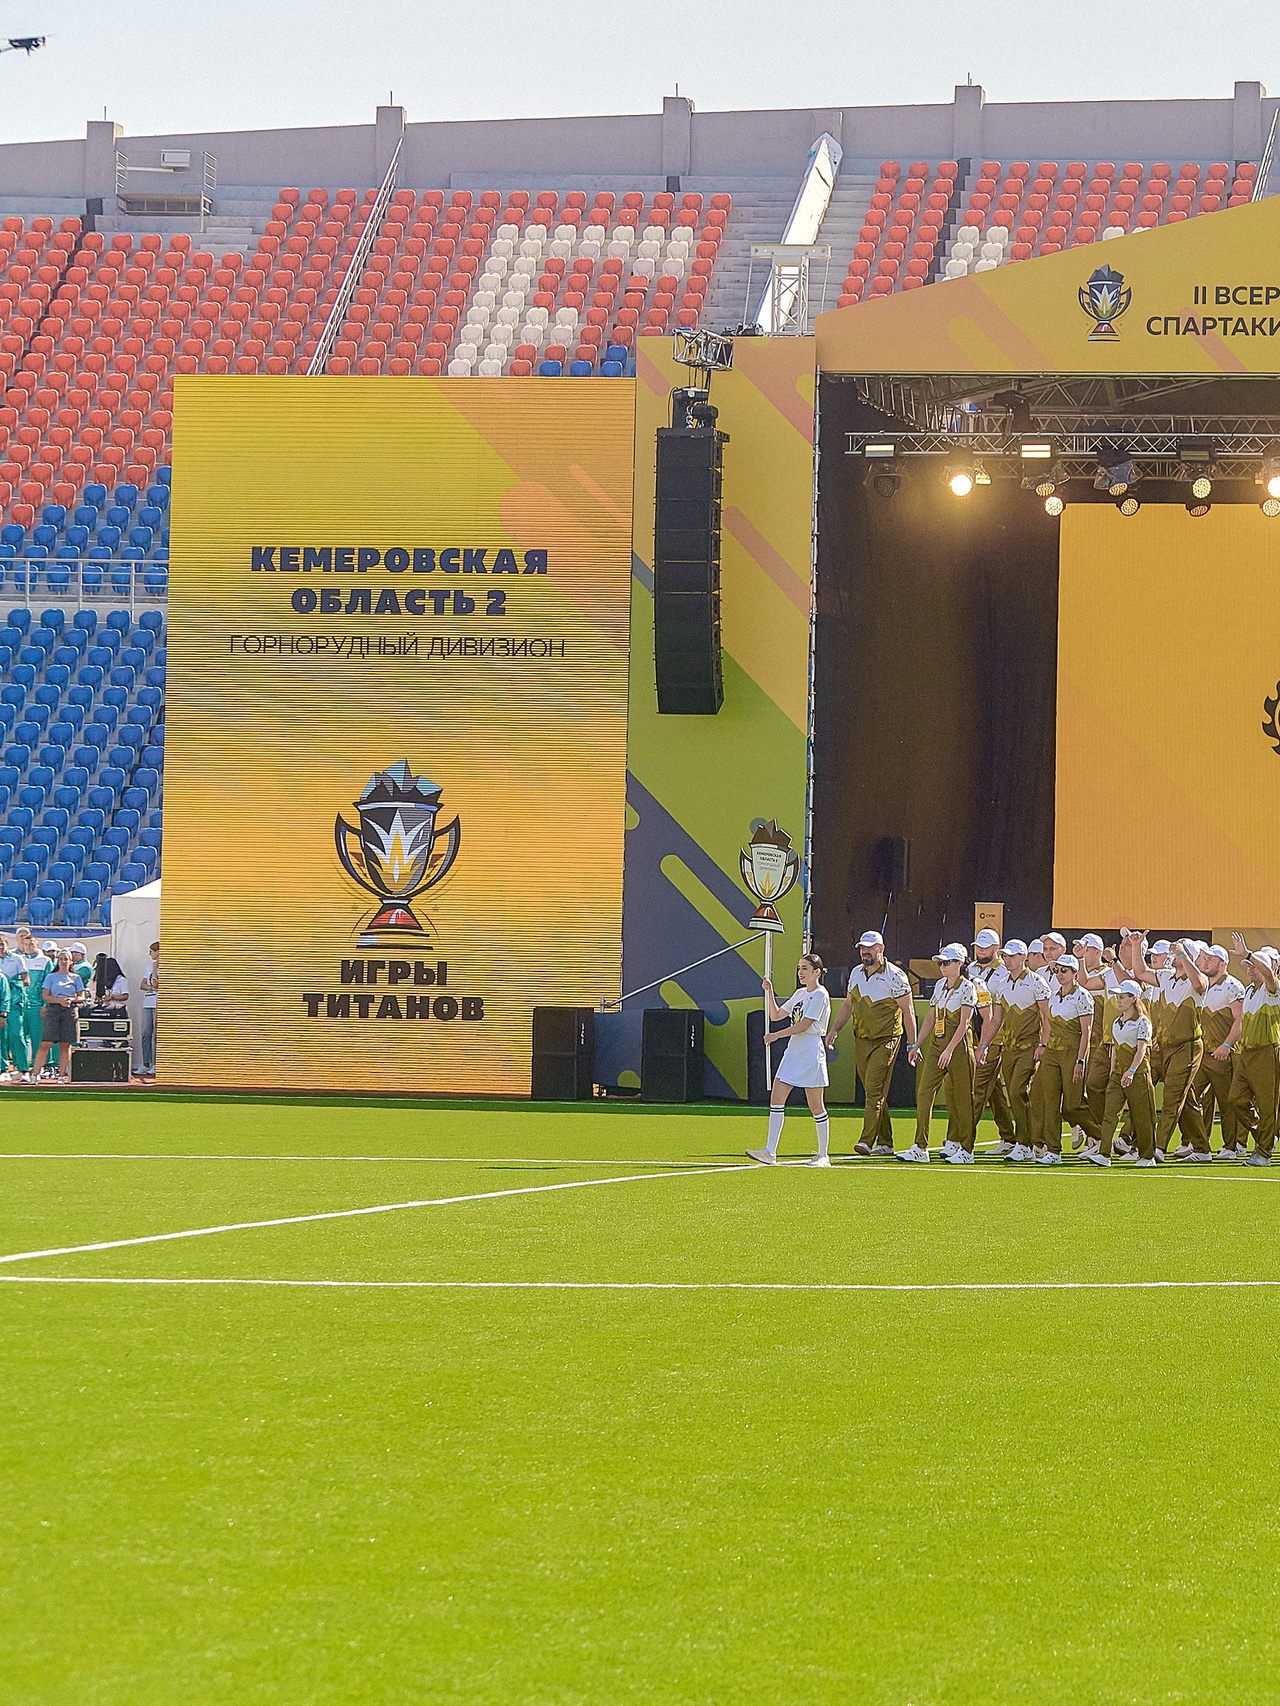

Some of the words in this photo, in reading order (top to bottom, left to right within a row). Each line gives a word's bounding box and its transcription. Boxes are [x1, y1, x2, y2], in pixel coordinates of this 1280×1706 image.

[1193, 286, 1207, 305] II
[251, 547, 549, 575] КЕМЕРОВСКАЯ
[291, 588, 475, 615] ОБЛАСТЬ
[485, 590, 507, 616] 2
[230, 632, 418, 659] ГОРНОРУДНЫЙ
[426, 636, 566, 660] ДИВИЗИОН
[341, 960, 447, 986] ИГРЫ
[303, 993, 484, 1020] ТИТАНОВ
